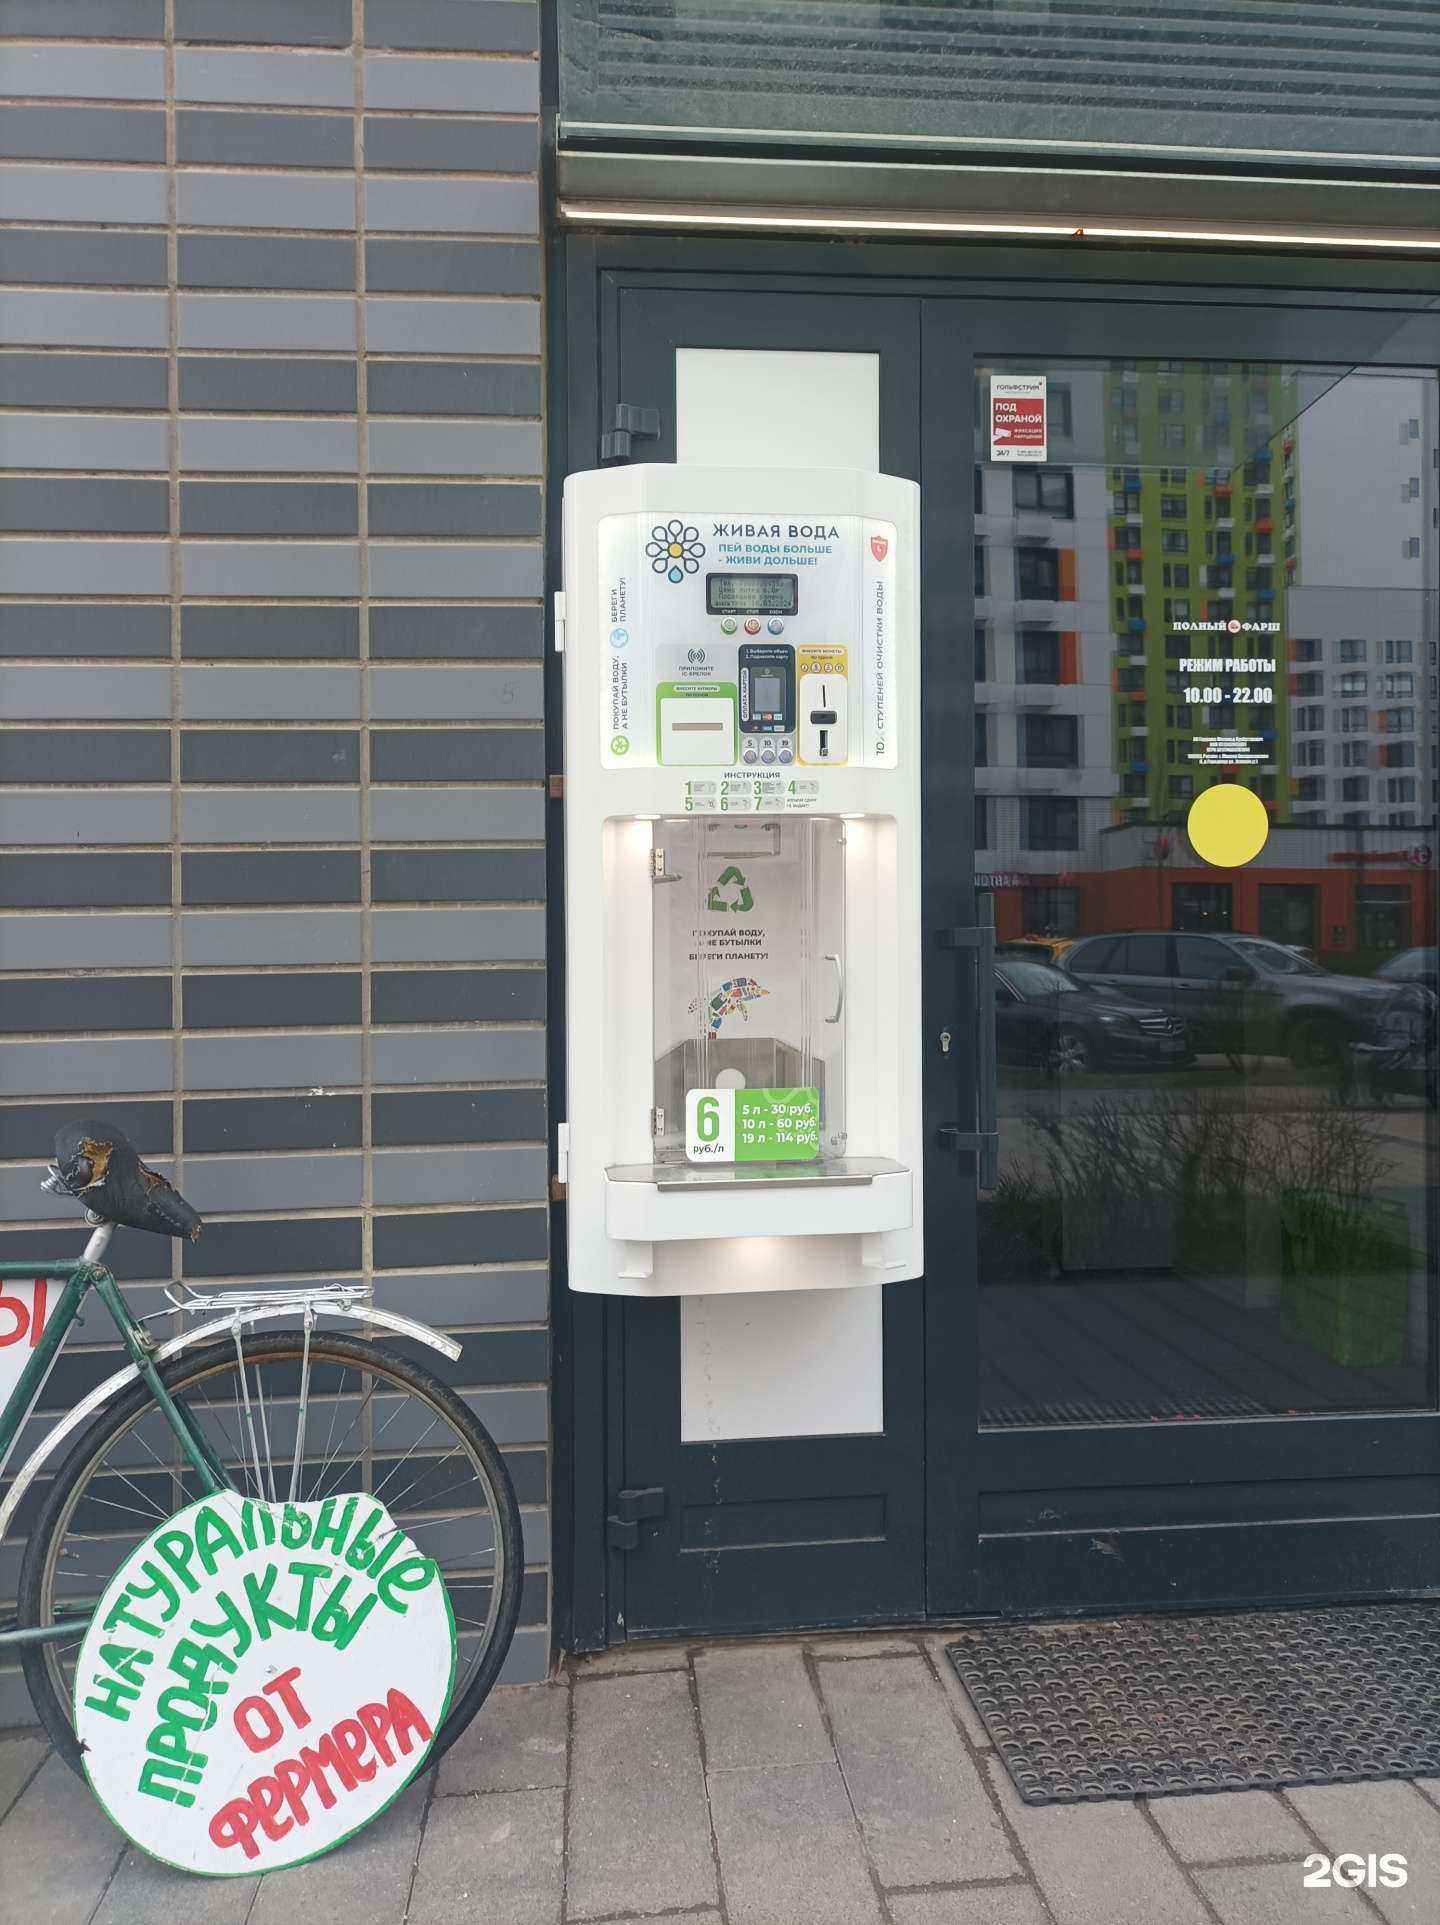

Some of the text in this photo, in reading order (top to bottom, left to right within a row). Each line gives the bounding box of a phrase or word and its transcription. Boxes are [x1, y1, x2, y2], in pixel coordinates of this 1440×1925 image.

[995, 402, 1017, 413] ПОД
[995, 413, 1042, 423] ОХРАНОЙ
[713, 523, 840, 541] ЖИВАЯ ВОДА
[718, 543, 833, 554] ПЕЙ ВОДЫ БОЛЬШЕ
[726, 556, 761, 565] ЖИВИ
[763, 557, 817, 567] ДОЛЬШЕ!
[876, 581, 885, 615] ВОДЫ
[1173, 620, 1281, 631] ПОЛНЫЙ ФАРШ
[876, 618, 885, 669] ОЧИСТКИ
[1179, 658, 1276, 672] РЕЖИМ РАБОТЫ
[875, 673, 885, 730] СТУПЕНЕЙ
[1183, 687, 1222, 703] 10.00
[1233, 687, 1273, 703] 22.00
[612, 685, 620, 730] ПОКУПАЙ
[684, 781, 692, 795] 1
[720, 781, 729, 796] 2
[753, 780, 762, 795] 3
[787, 780, 796, 795] 4
[684, 797, 693, 811] 5
[720, 797, 729, 811] 6
[754, 796, 763, 810] 7
[739, 929, 766, 938] ВОДУ,
[742, 1104, 750, 1114] 5
[752, 1106, 761, 1114] л
[771, 1104, 786, 1114] 30
[789, 1103, 813, 1116] руб.
[696, 1096, 720, 1142] 6
[742, 1119, 755, 1129] 10
[757, 1120, 766, 1129] л
[776, 1118, 792, 1128] 60
[795, 1117, 817, 1130] руб.
[742, 1133, 755, 1144] 19
[757, 1134, 766, 1143] л
[796, 1131, 818, 1144] руб.
[693, 1143, 725, 1155] руб./л
[138, 1561, 378, 1808] ПРОДУКТЫ
[233, 1666, 317, 1754] ОТ
[208, 1687, 433, 1860] ФЕРМЕРА
